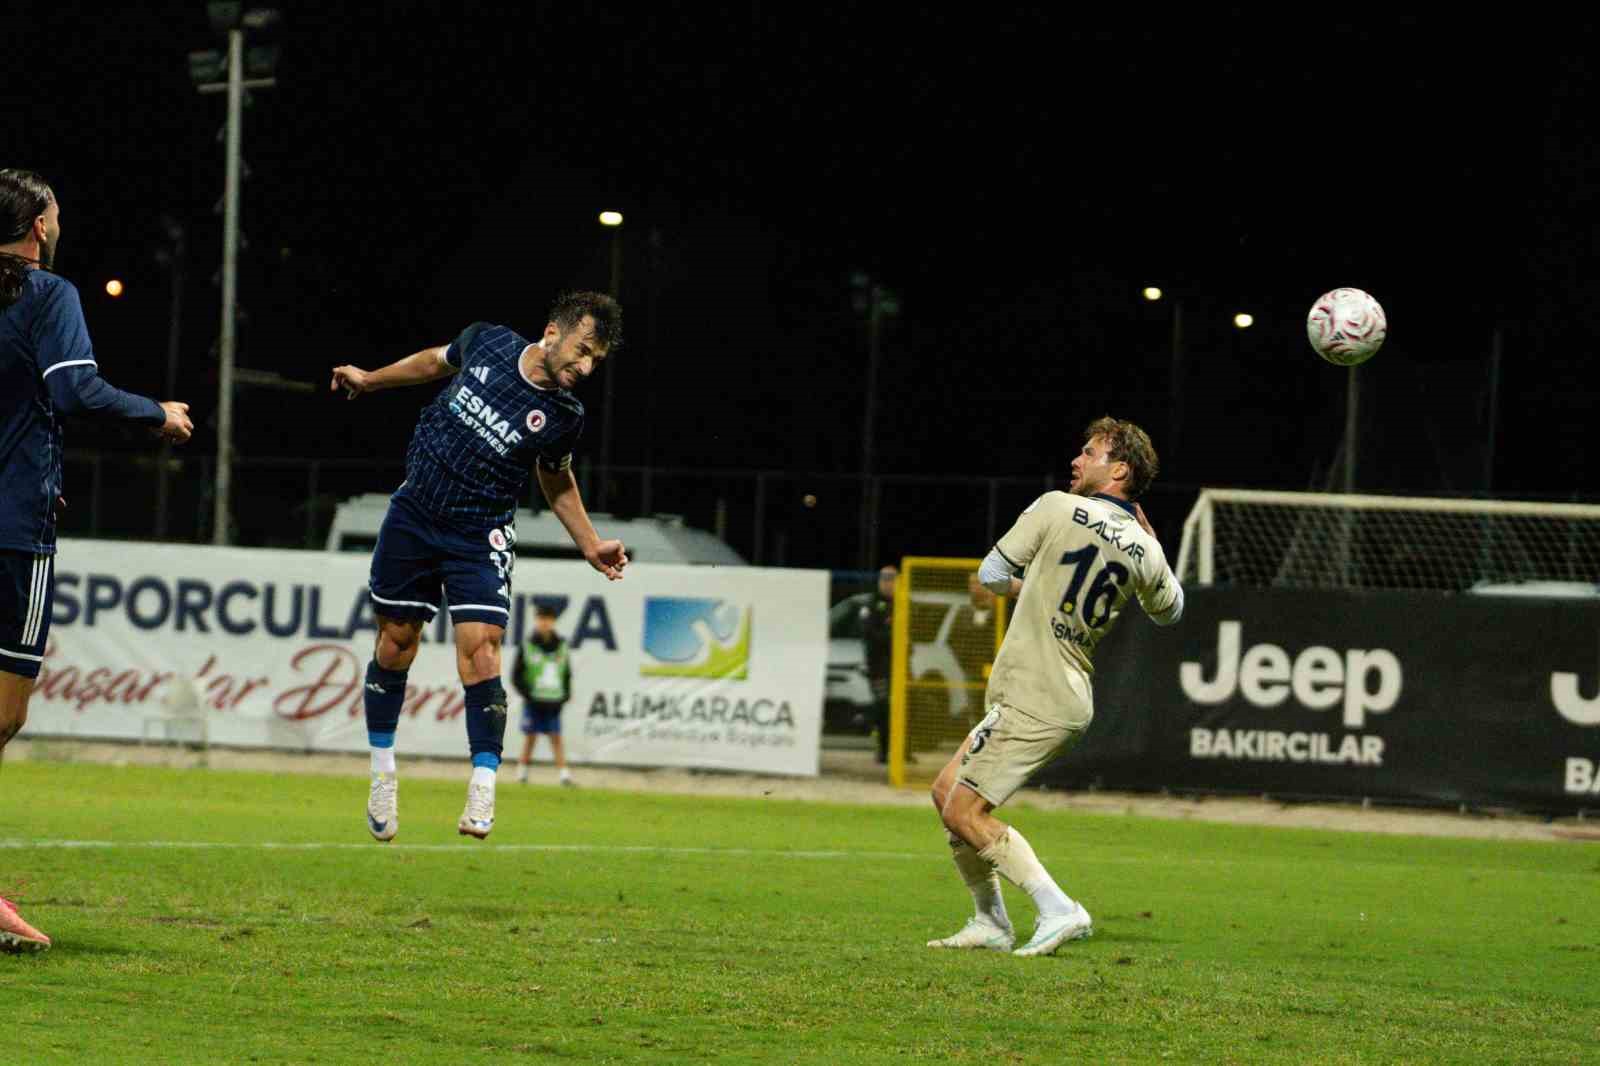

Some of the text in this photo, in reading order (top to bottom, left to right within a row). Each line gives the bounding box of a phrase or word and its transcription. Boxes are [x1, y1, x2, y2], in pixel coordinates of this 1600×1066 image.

[456, 386, 522, 444] ESNAF
[1072, 507, 1145, 564] BALKAR
[1060, 543, 1129, 629] 16
[1179, 620, 1403, 727] Jeep
[1190, 728, 1385, 765] BAKIRCILAR
